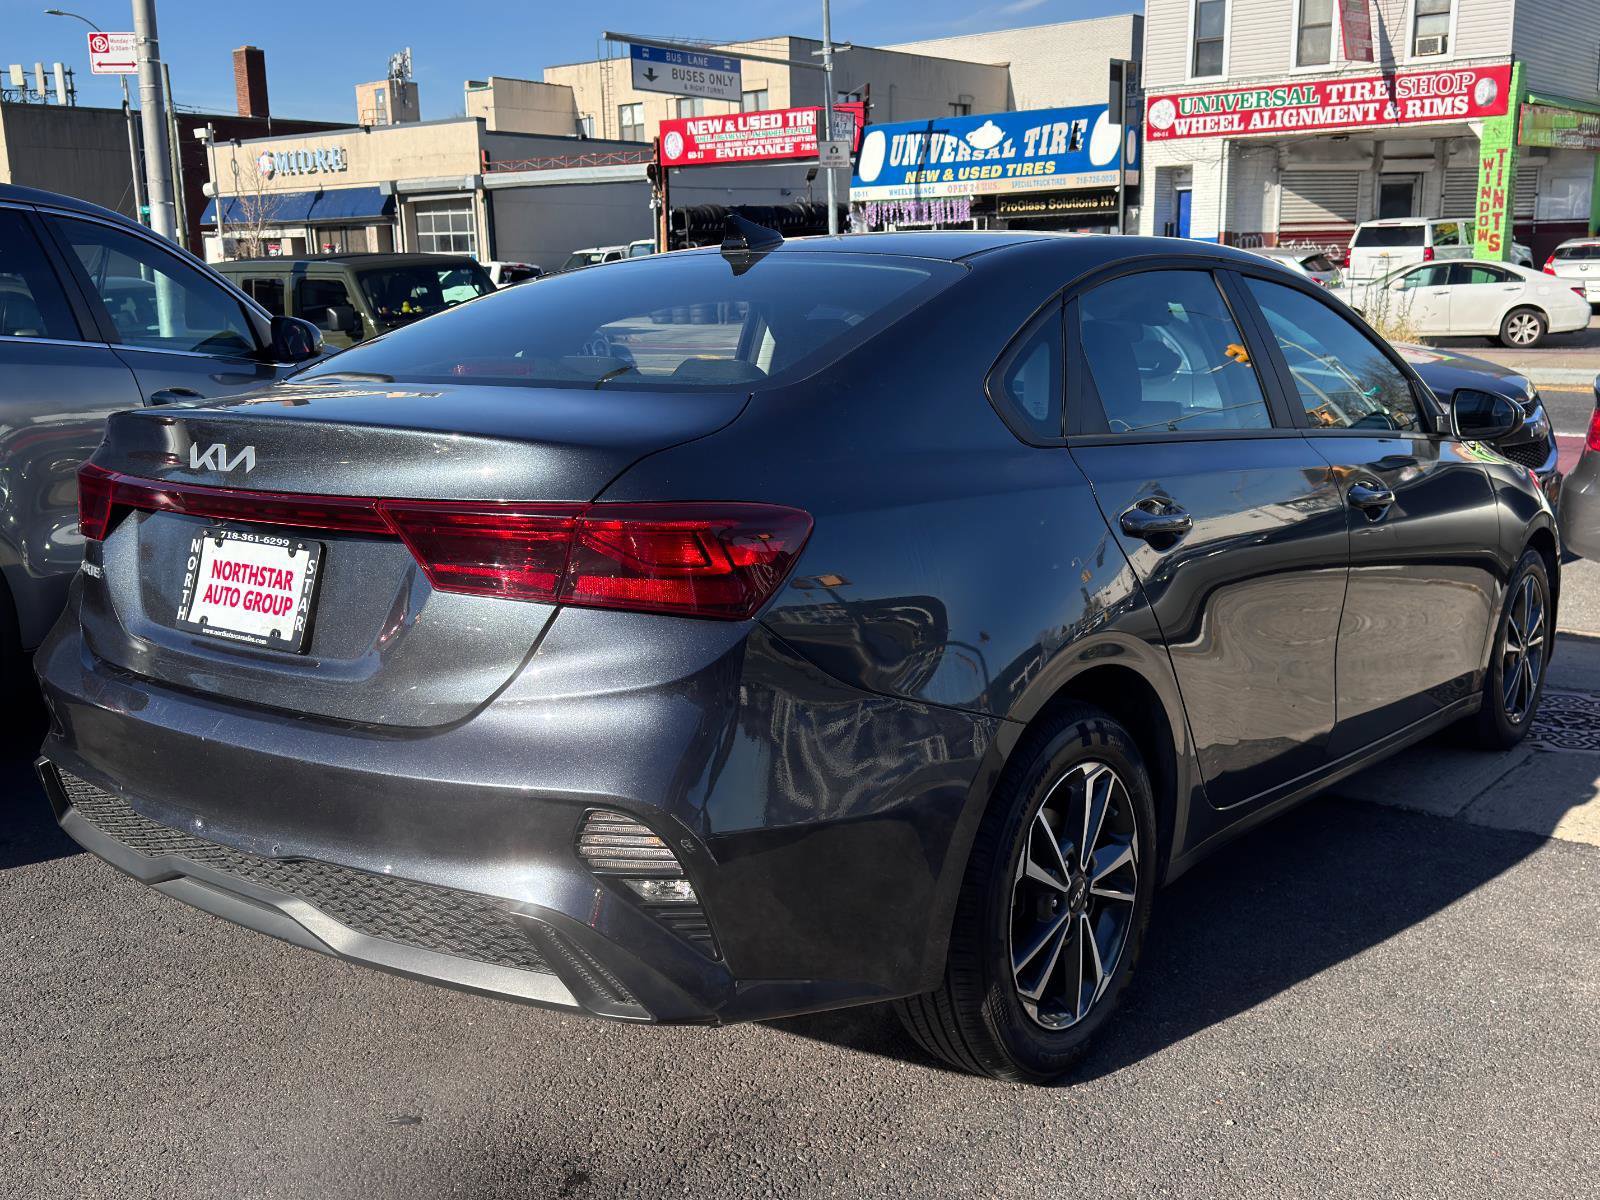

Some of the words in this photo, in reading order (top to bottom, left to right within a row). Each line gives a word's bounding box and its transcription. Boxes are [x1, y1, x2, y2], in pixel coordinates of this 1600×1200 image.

[665, 52, 682, 63] BUS
[687, 55, 709, 67] LANE
[671, 68, 705, 83] BUSES
[709, 73, 734, 87] ONLY
[689, 84, 705, 92] RIGHT
[707, 86, 725, 95] TURNS
[1178, 86, 1321, 116] UNIVERSAL
[1326, 80, 1390, 104] TIRE
[1396, 72, 1476, 99] SHOP
[686, 118, 723, 135] NEW
[724, 119, 737, 132] &
[738, 113, 782, 131] USED
[786, 110, 817, 127] TIR
[1173, 114, 1244, 136] WHEEL
[1248, 102, 1380, 130] ALIGNMENT
[1383, 100, 1402, 120] &
[1404, 96, 1469, 119] RIMS
[716, 143, 795, 159] ENTRANCE
[890, 133, 1017, 167] UNIVERSAL
[1023, 119, 1088, 158] TIRE
[905, 169, 940, 184] NEW
[942, 168, 954, 182] &
[957, 165, 1003, 181] USED
[1006, 161, 1056, 176] TIRES
[947, 183, 968, 194] OPEN
[1000, 200, 1046, 212] ProGlass
[1049, 197, 1098, 210] Solutions
[1101, 195, 1116, 207] NY
[1477, 157, 1496, 242] WINDOW
[1487, 148, 1508, 252] TINTS
[190, 441, 256, 474] KIA
[220, 531, 290, 547] 718-361-6299
[176, 538, 201, 621] NORTH
[211, 559, 294, 592] NORTHSTAR
[202, 583, 241, 608] AUTO
[242, 590, 294, 617] GROUP
[294, 558, 317, 632] STAR
